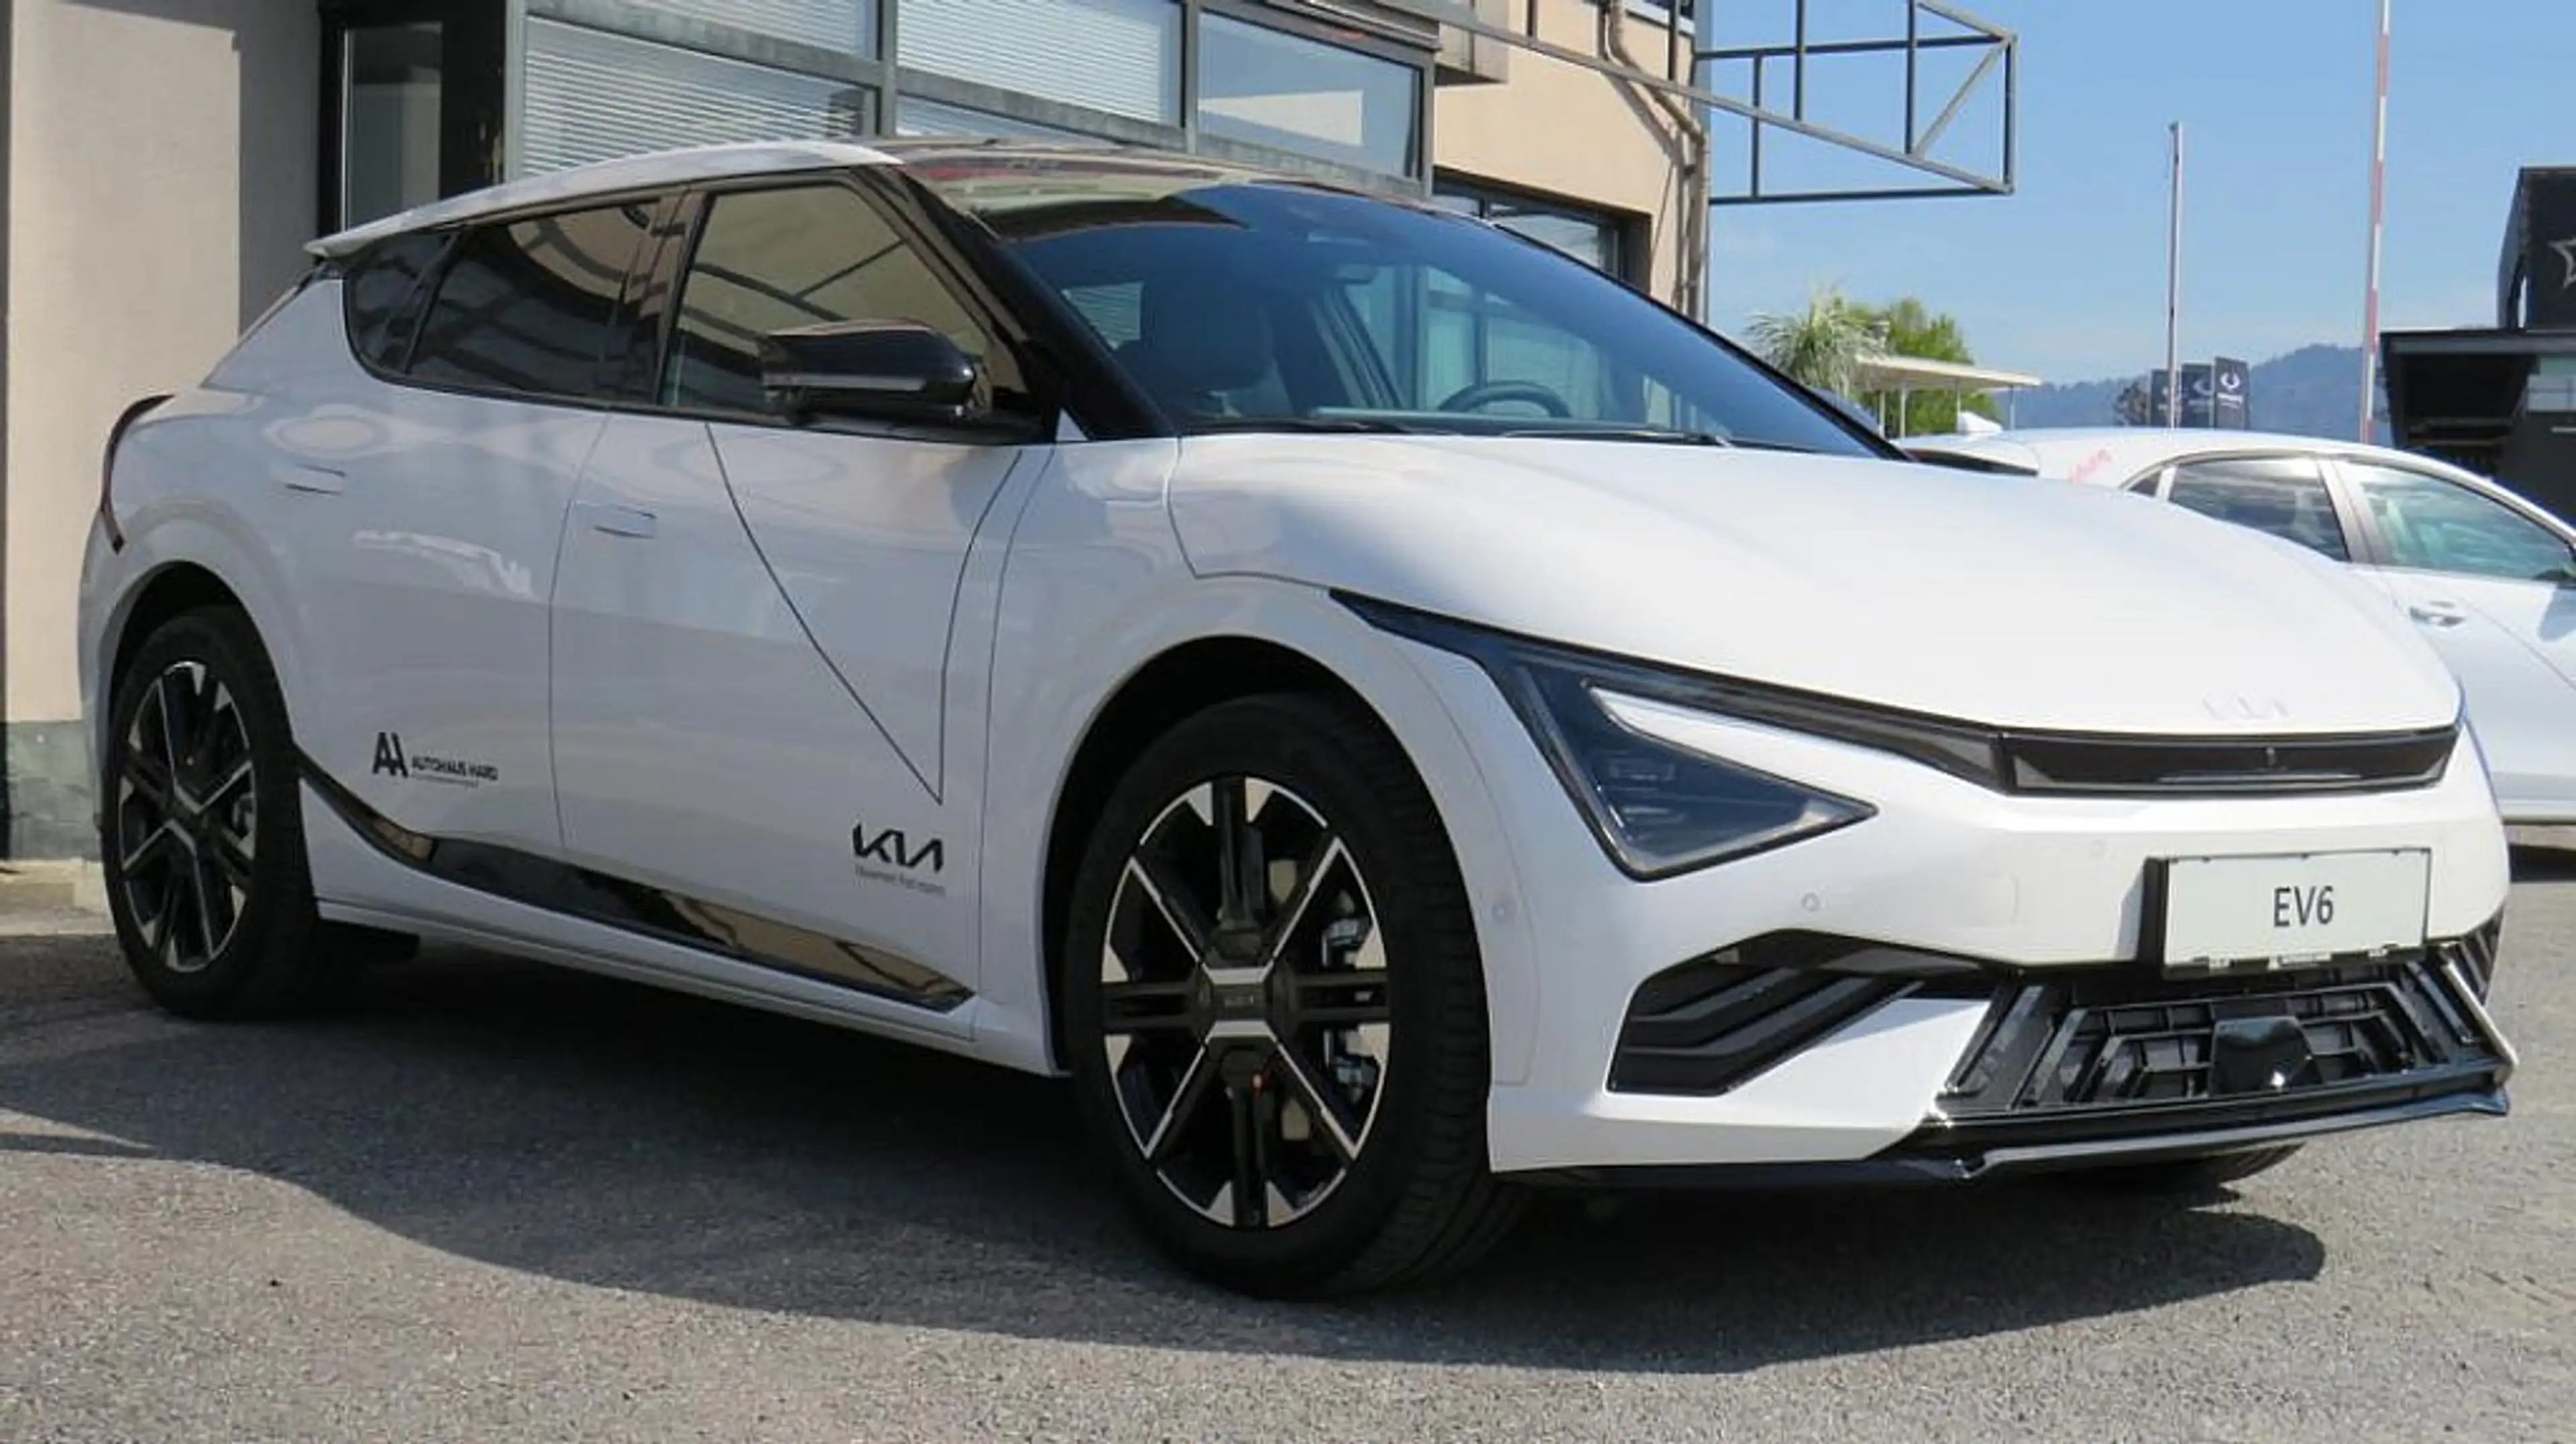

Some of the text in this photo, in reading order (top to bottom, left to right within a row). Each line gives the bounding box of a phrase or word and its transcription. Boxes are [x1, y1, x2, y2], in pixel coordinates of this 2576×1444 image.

[412, 755, 467, 776] AUTOHAUS
[853, 823, 944, 874] KIA
[2273, 885, 2334, 928] EV6
